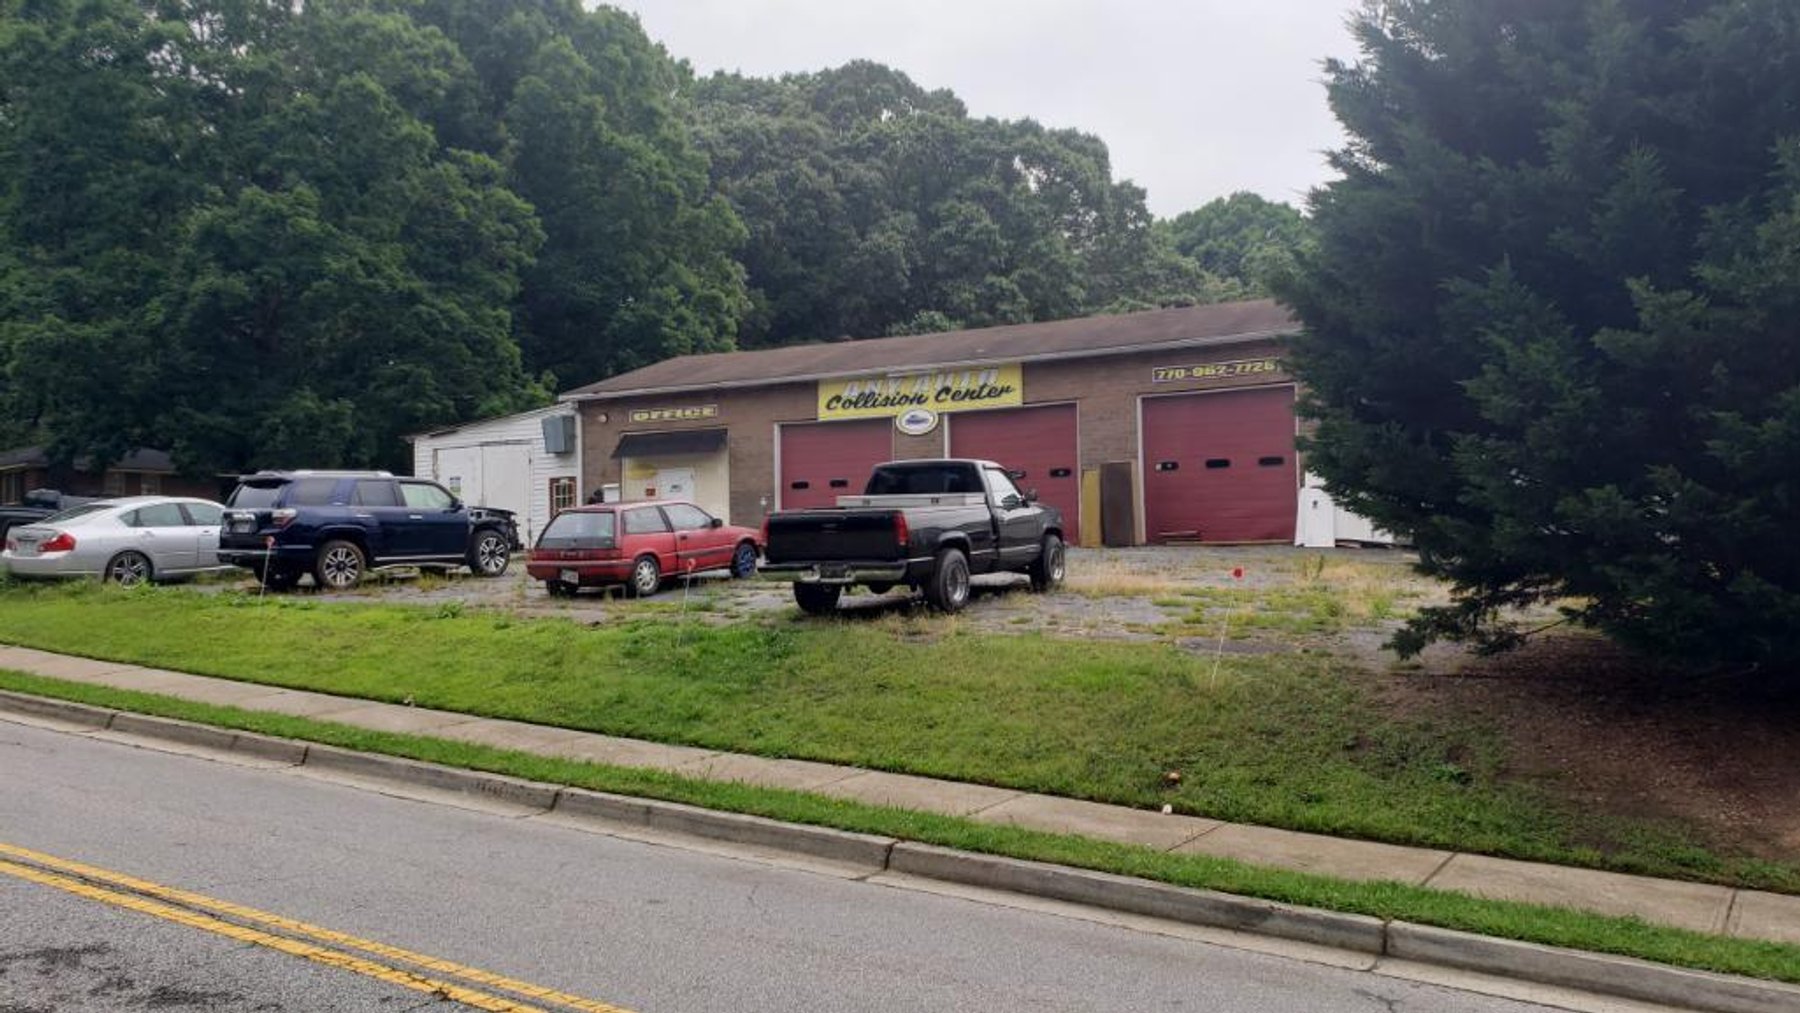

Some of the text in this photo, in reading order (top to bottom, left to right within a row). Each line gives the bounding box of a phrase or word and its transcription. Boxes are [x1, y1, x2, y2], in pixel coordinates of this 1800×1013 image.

[826, 383, 1014, 410] Collision Center
[633, 407, 714, 421] OFFICE
